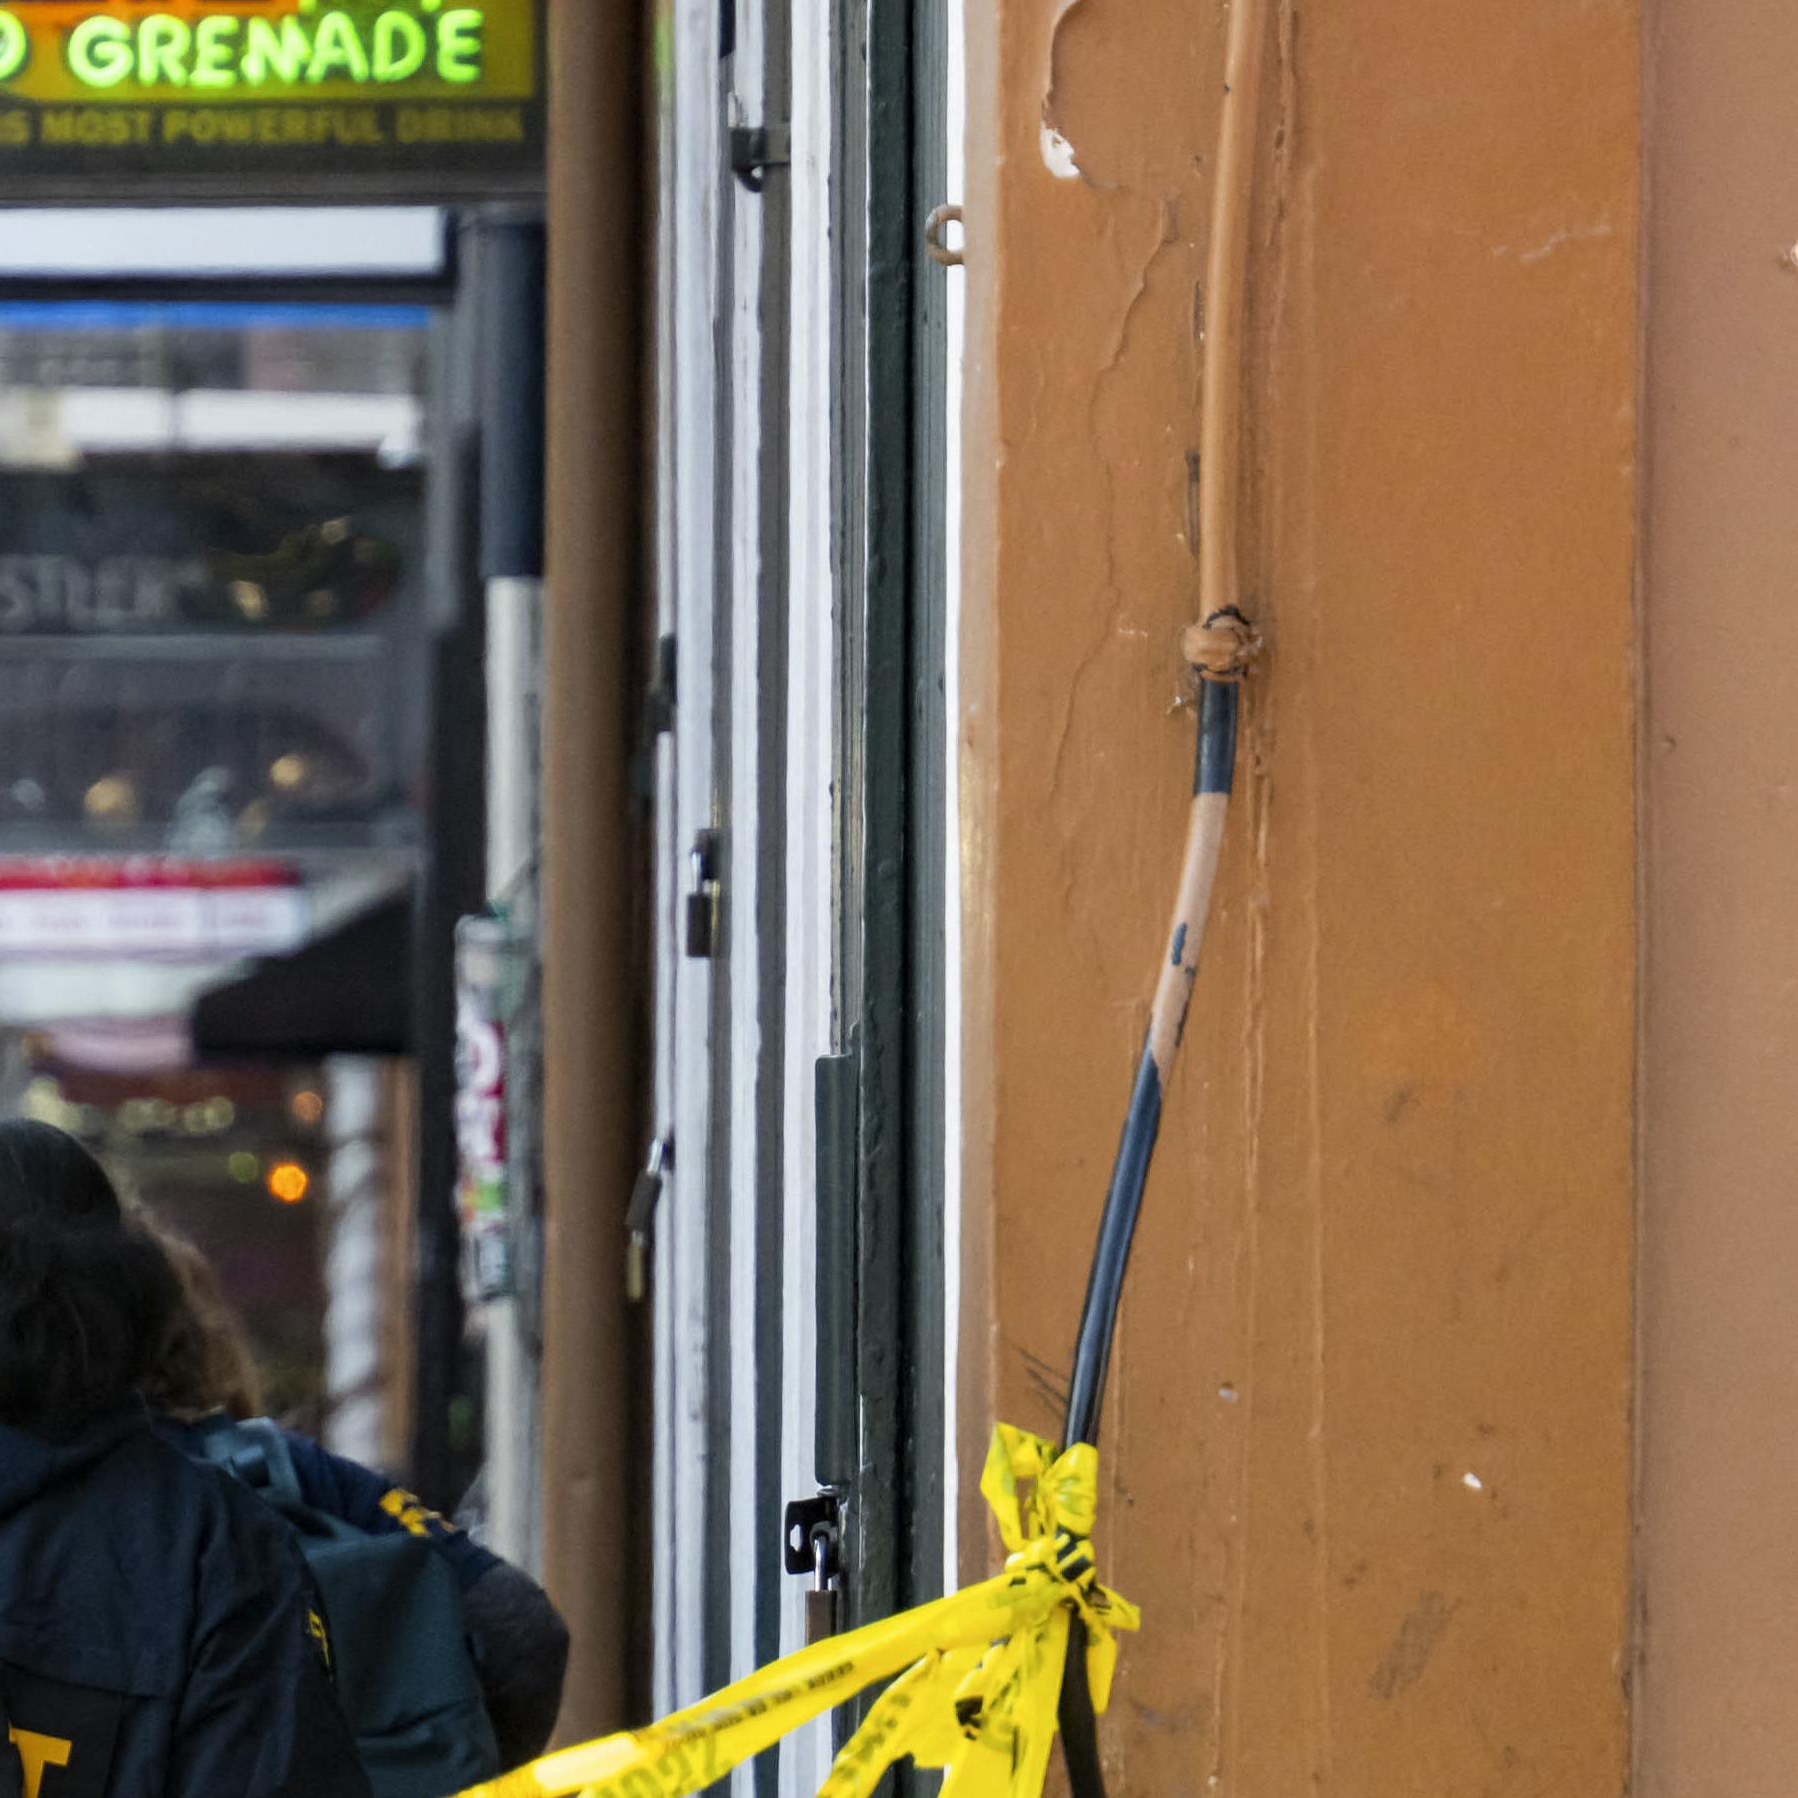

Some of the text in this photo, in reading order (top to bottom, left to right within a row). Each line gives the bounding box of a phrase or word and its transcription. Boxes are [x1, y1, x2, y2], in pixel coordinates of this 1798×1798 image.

[67, 7, 484, 88] GRENADE
[39, 109, 151, 146] MOST
[163, 107, 384, 145] POWERFUL
[395, 108, 524, 145] DRINK
